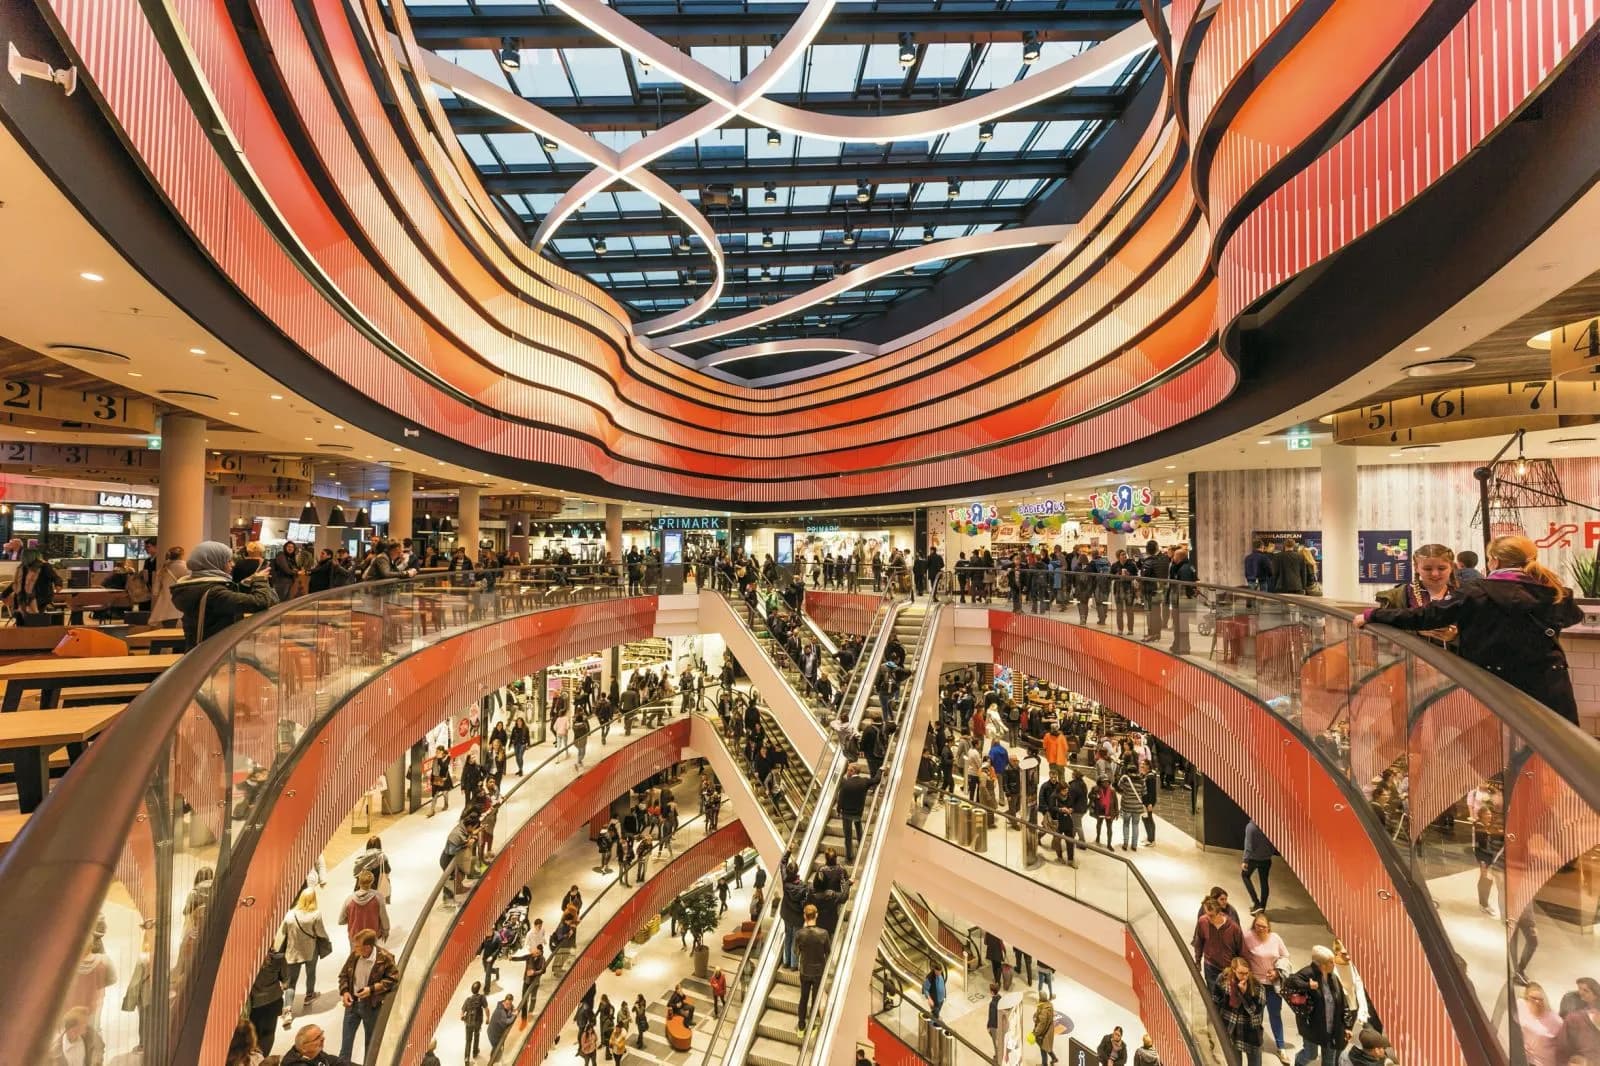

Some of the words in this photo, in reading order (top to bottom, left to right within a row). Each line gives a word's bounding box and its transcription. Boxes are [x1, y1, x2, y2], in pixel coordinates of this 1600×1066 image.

[1573, 319, 1600, 358] 4
[3, 380, 31, 408] 2
[93, 393, 118, 419] 3
[1368, 404, 1386, 430] 5
[1430, 391, 1455, 419] 6
[1522, 381, 1547, 410] 7
[8, 443, 25, 461] 2
[65, 446, 81, 464] 3
[221, 455, 236, 470] 6
[270, 458, 281, 474] 7
[658, 517, 720, 529] PRIMARK
